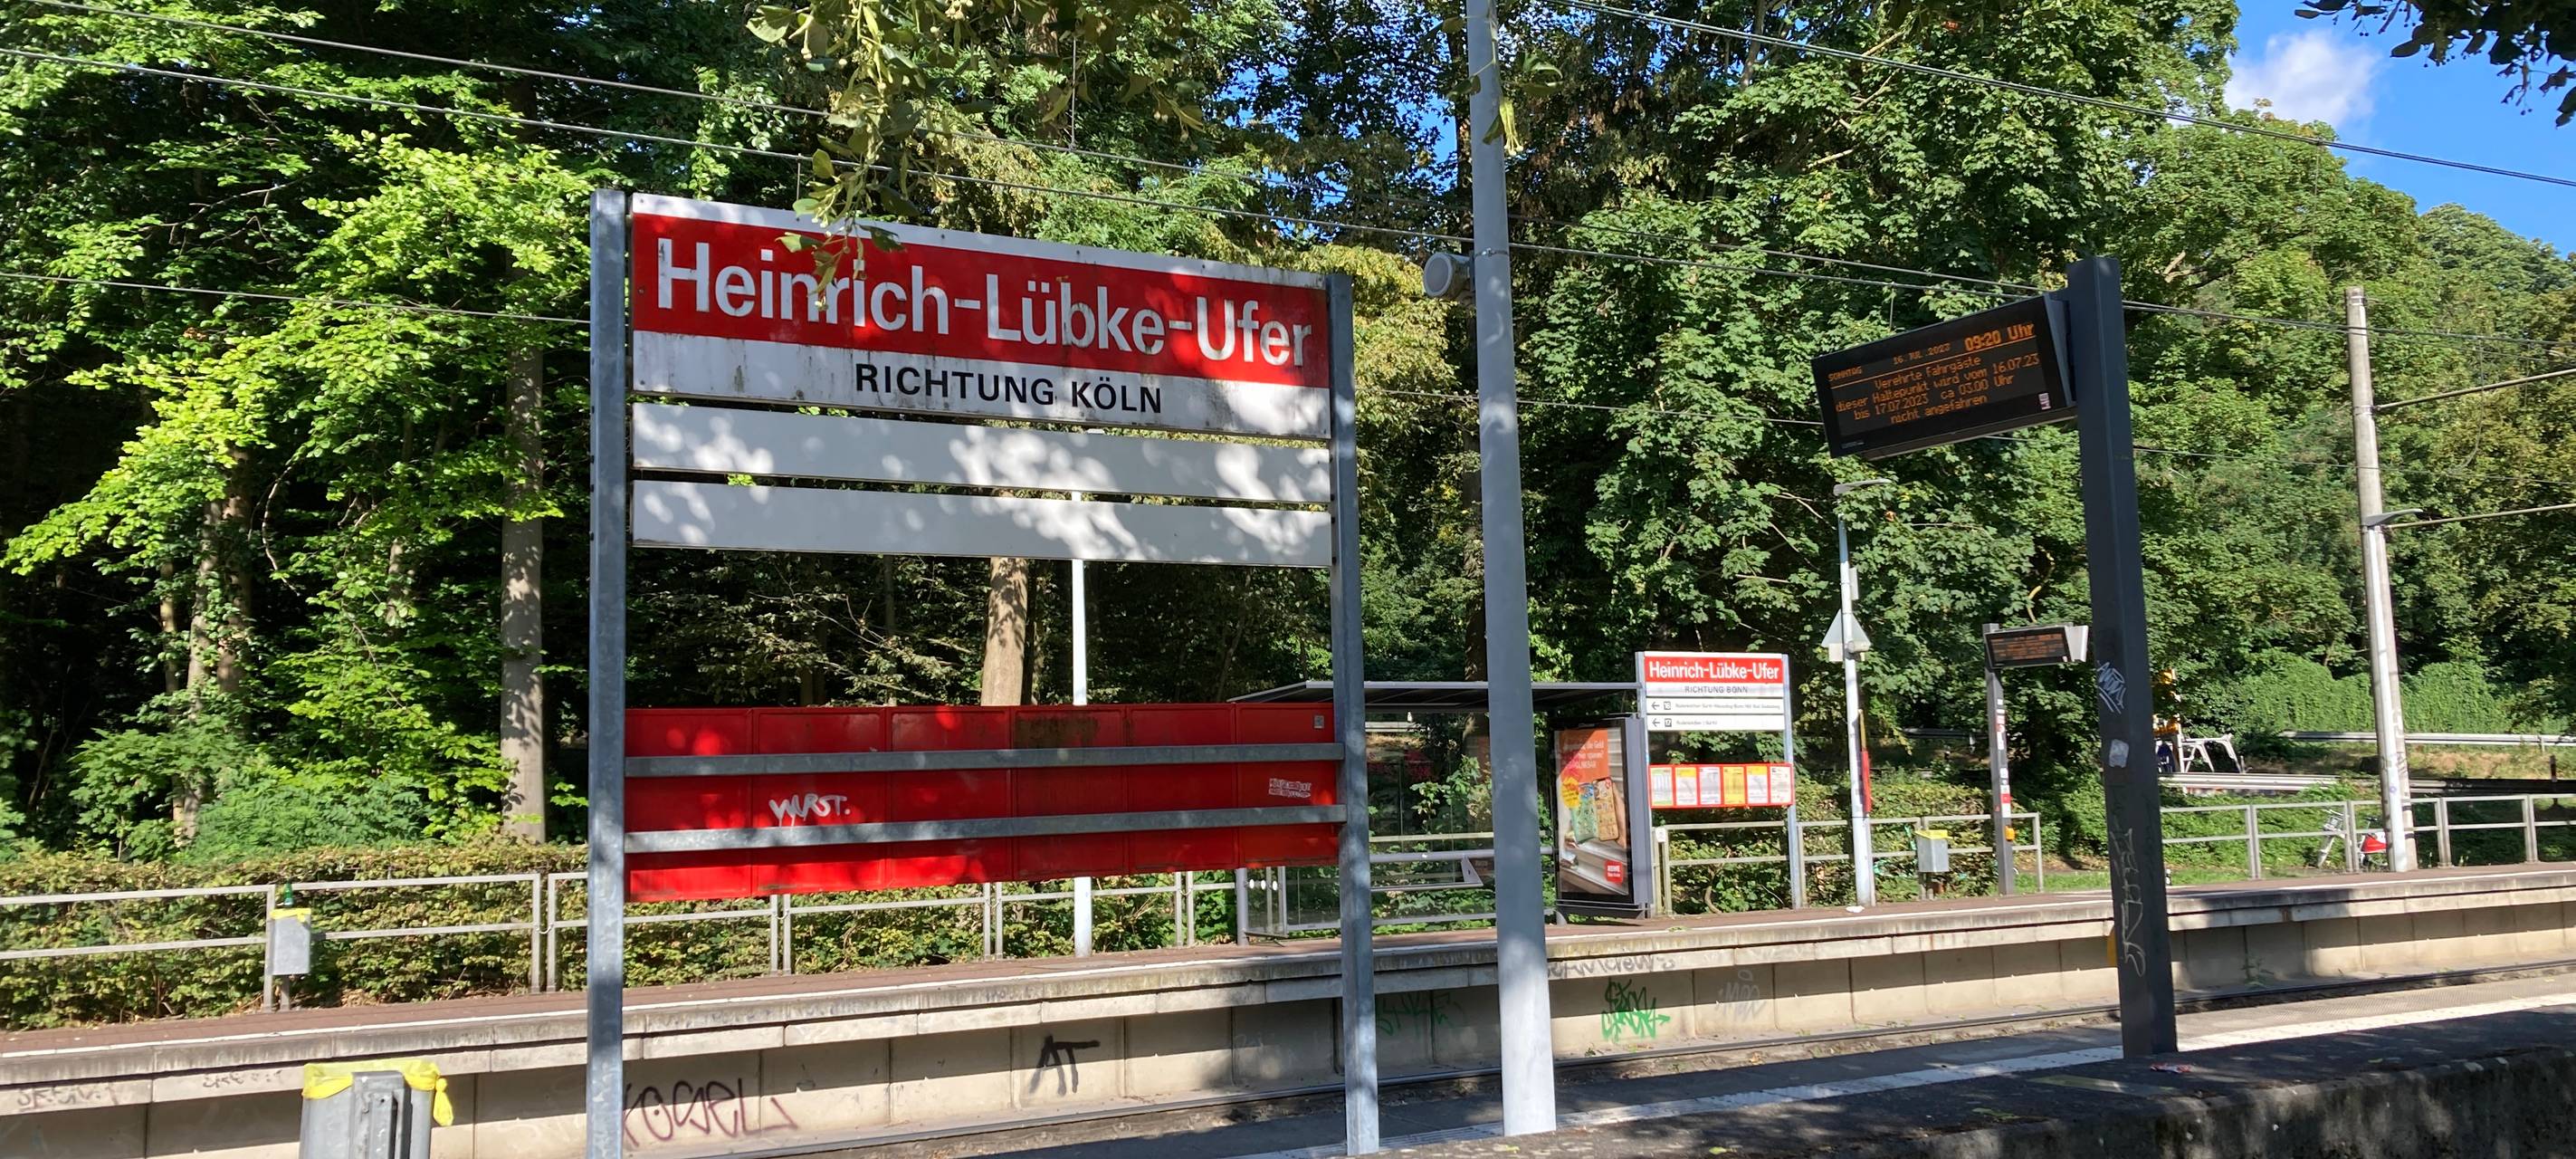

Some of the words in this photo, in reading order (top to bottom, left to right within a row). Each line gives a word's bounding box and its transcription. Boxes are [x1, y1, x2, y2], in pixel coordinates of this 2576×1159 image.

[657, 237, 1312, 367] Heinrich-Lübke-Ufer
[1964, 330, 2001, 351] 09:20
[2007, 322, 2035, 340] Uhr
[855, 363, 1054, 406] RICHTUNG
[1072, 379, 1162, 414] KÖLN
[1874, 370, 1922, 389] Verehrte
[1925, 356, 1981, 378] Fahrgäste
[1836, 397, 1869, 413] dieser
[1872, 381, 1929, 404] Haltepunkt
[1932, 372, 1961, 388] wird
[1963, 368, 1988, 381] vom
[1854, 409, 1871, 420] bis
[1993, 375, 2015, 388] Uhr
[1890, 408, 1921, 425] nicht
[1924, 395, 1988, 417] angefahren
[1648, 660, 1779, 680] Heinrich-Lübke-Ufer
[1684, 685, 1724, 694] RICHTUNG
[1726, 685, 1749, 694] BONN
